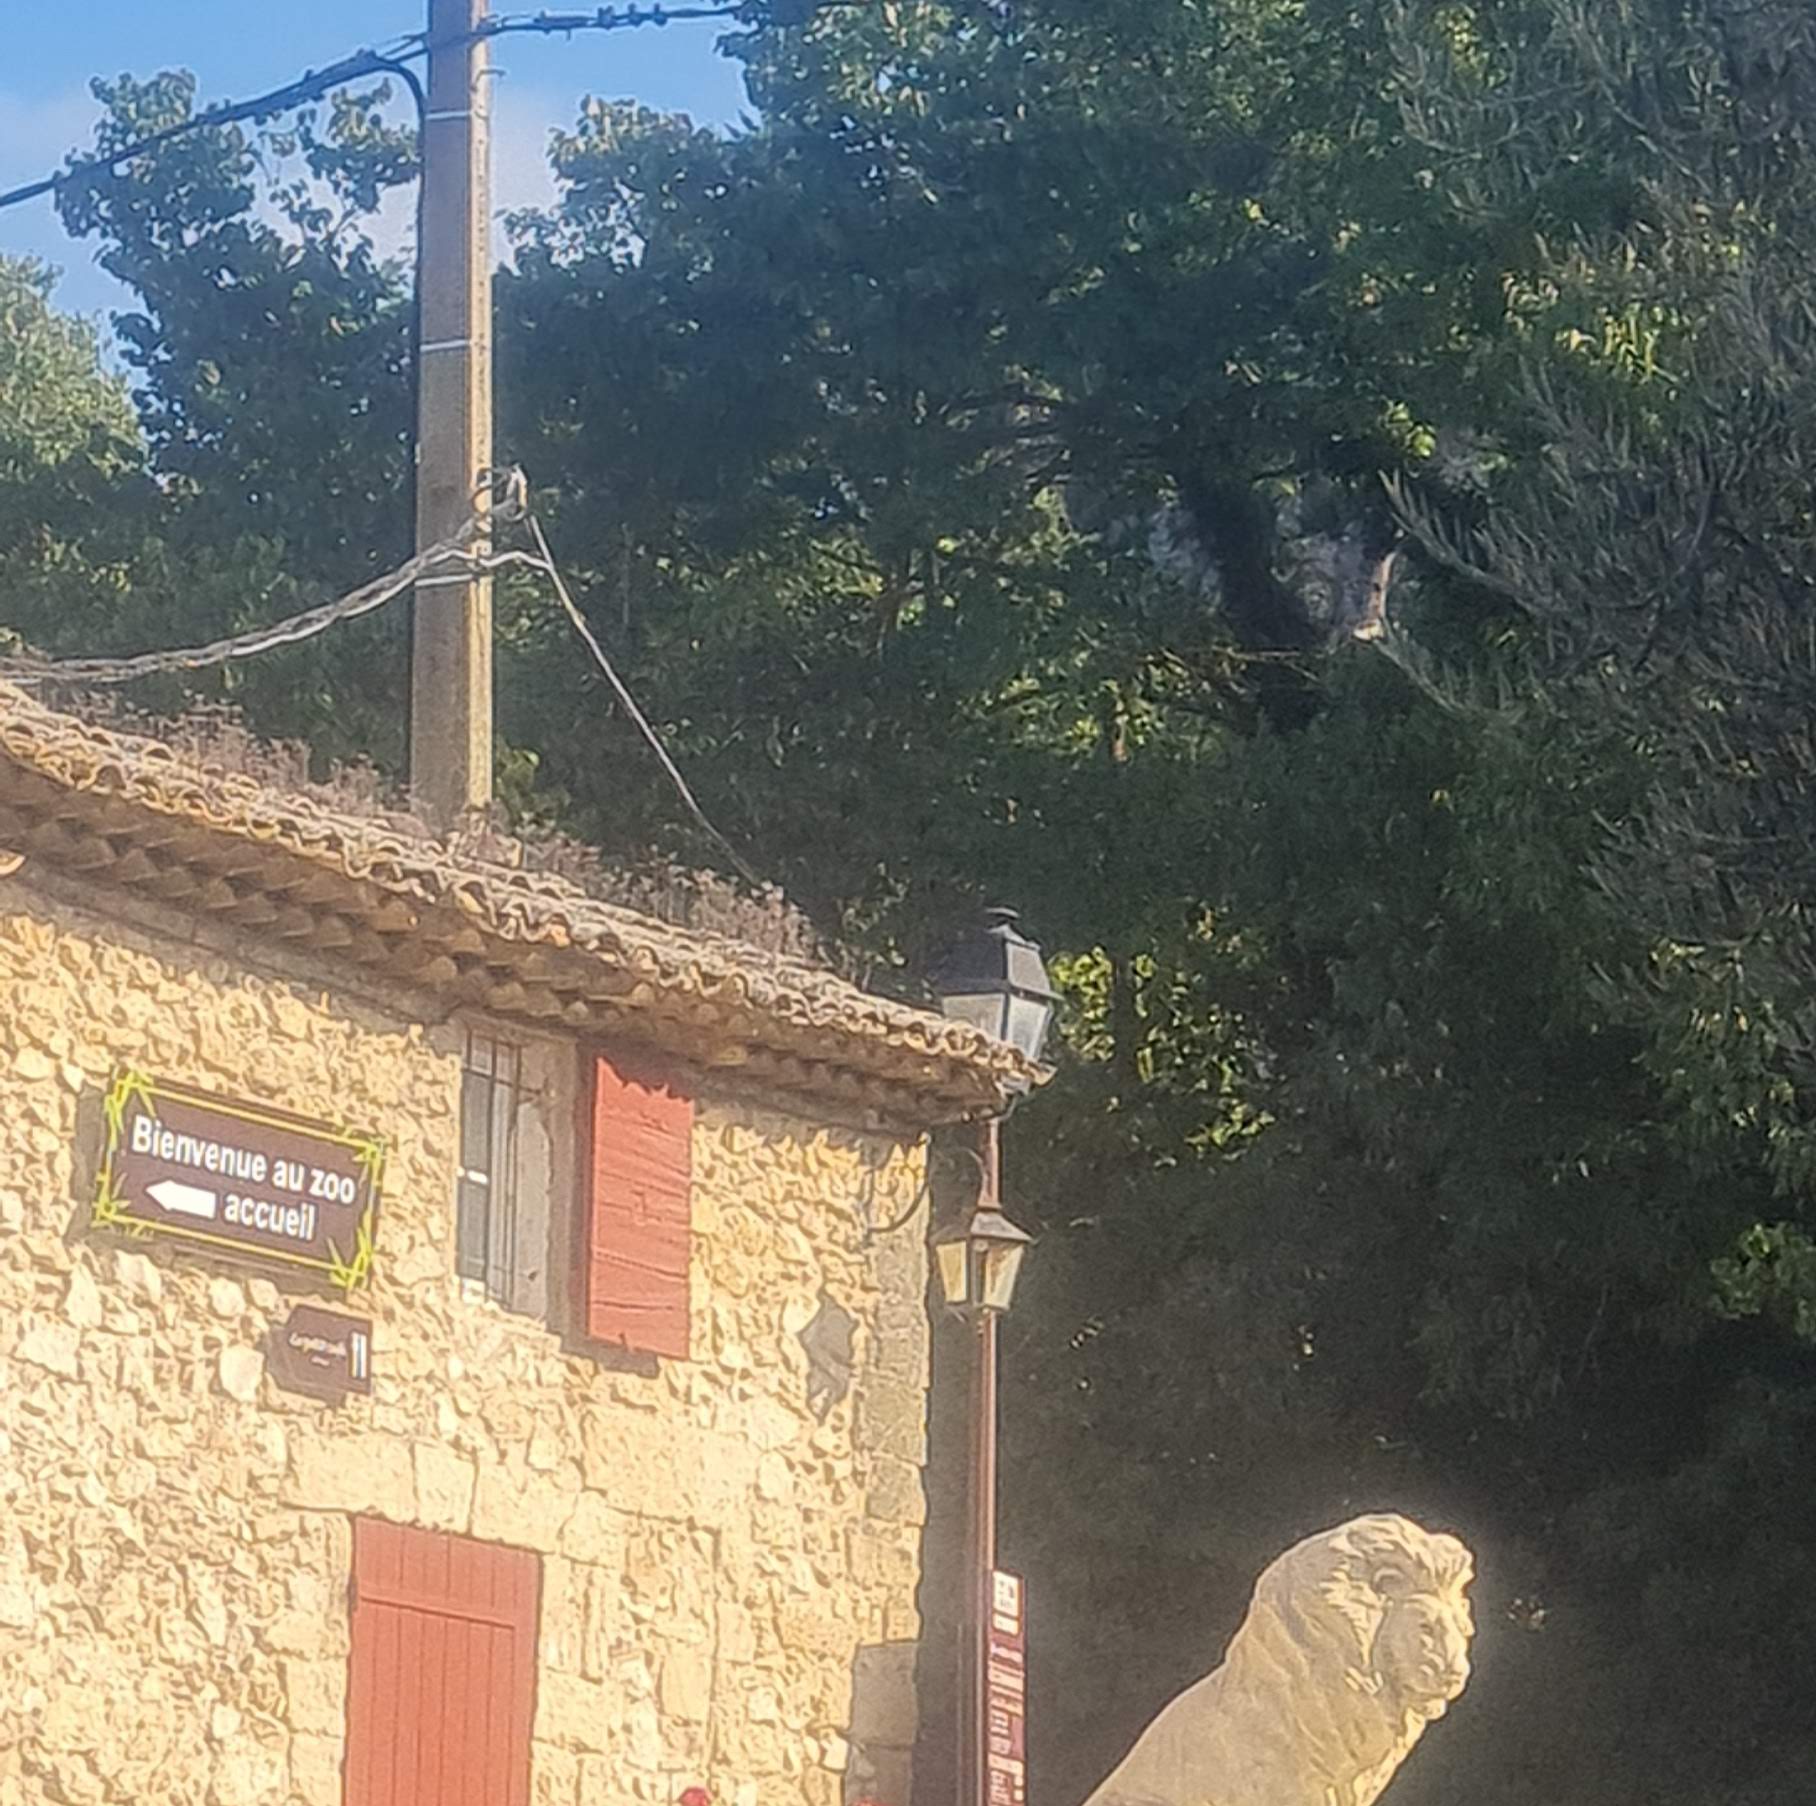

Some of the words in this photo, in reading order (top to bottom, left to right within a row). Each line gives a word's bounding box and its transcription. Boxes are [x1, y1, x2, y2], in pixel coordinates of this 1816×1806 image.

[132, 1115, 267, 1182] Bienvenue
[272, 1160, 304, 1192] au
[309, 1170, 356, 1204] zoo
[224, 1194, 316, 1240] accueil
